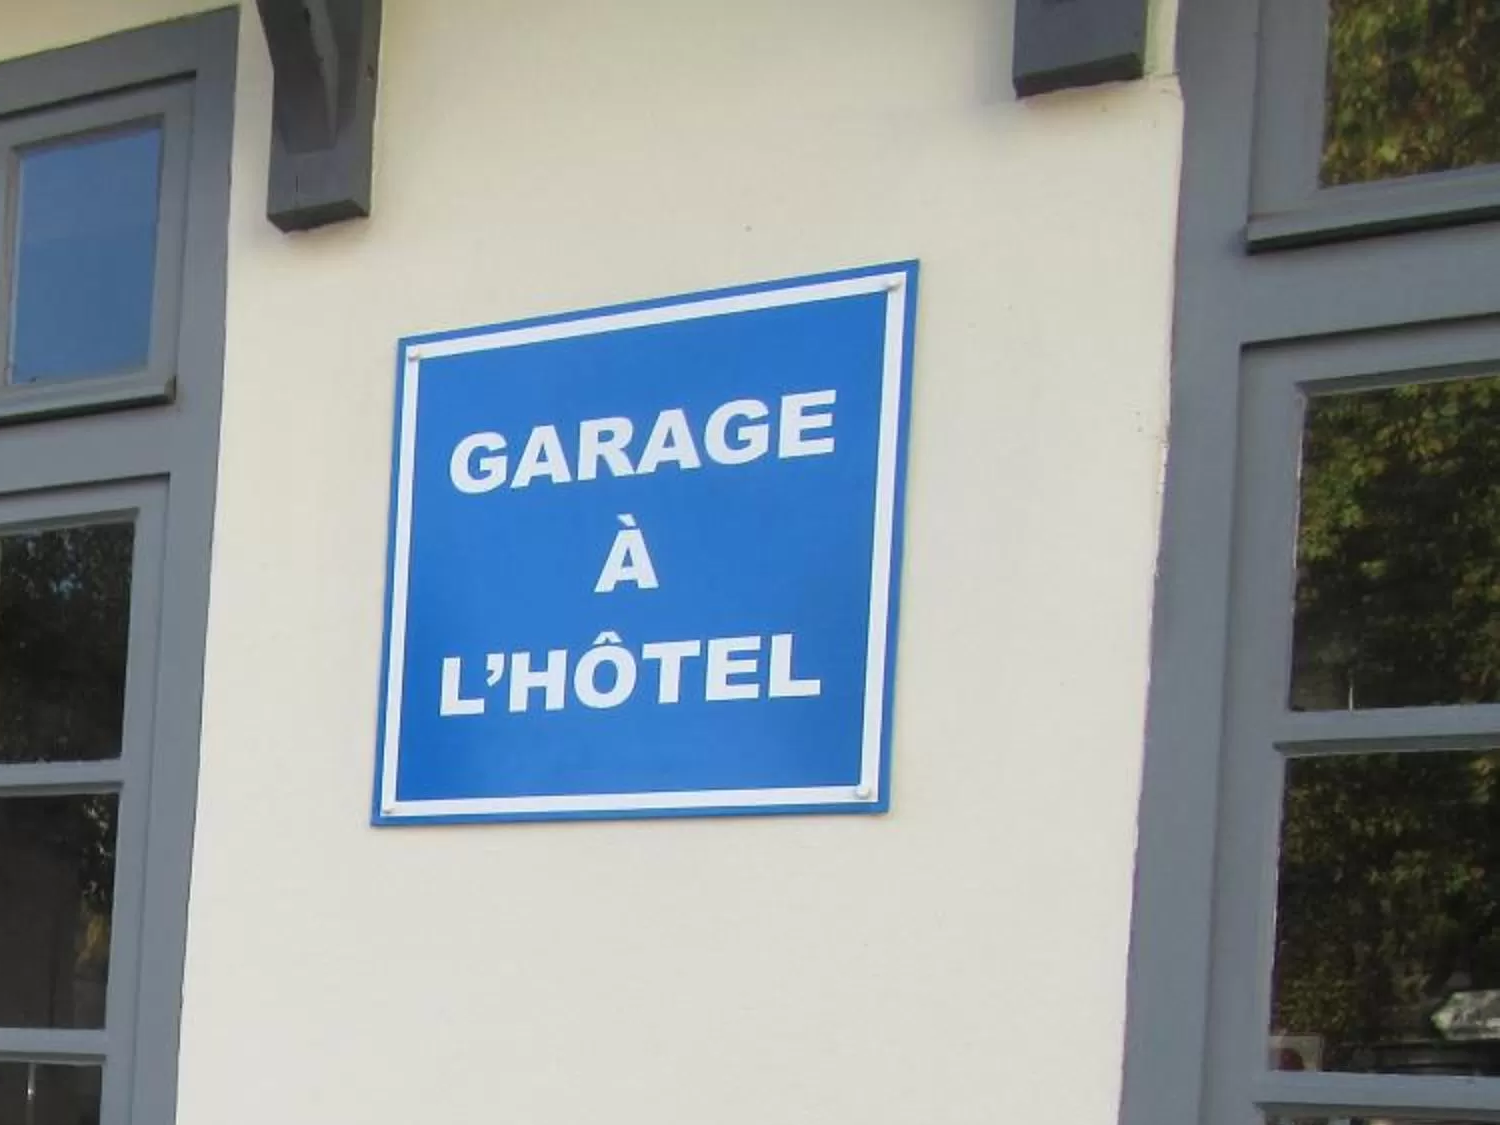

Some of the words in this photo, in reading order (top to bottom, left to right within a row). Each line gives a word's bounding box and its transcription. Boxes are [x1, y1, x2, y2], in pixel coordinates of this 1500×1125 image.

[449, 389, 837, 494] GARAGE
[594, 513, 659, 593] À
[439, 631, 821, 717] L'HÔTEL
